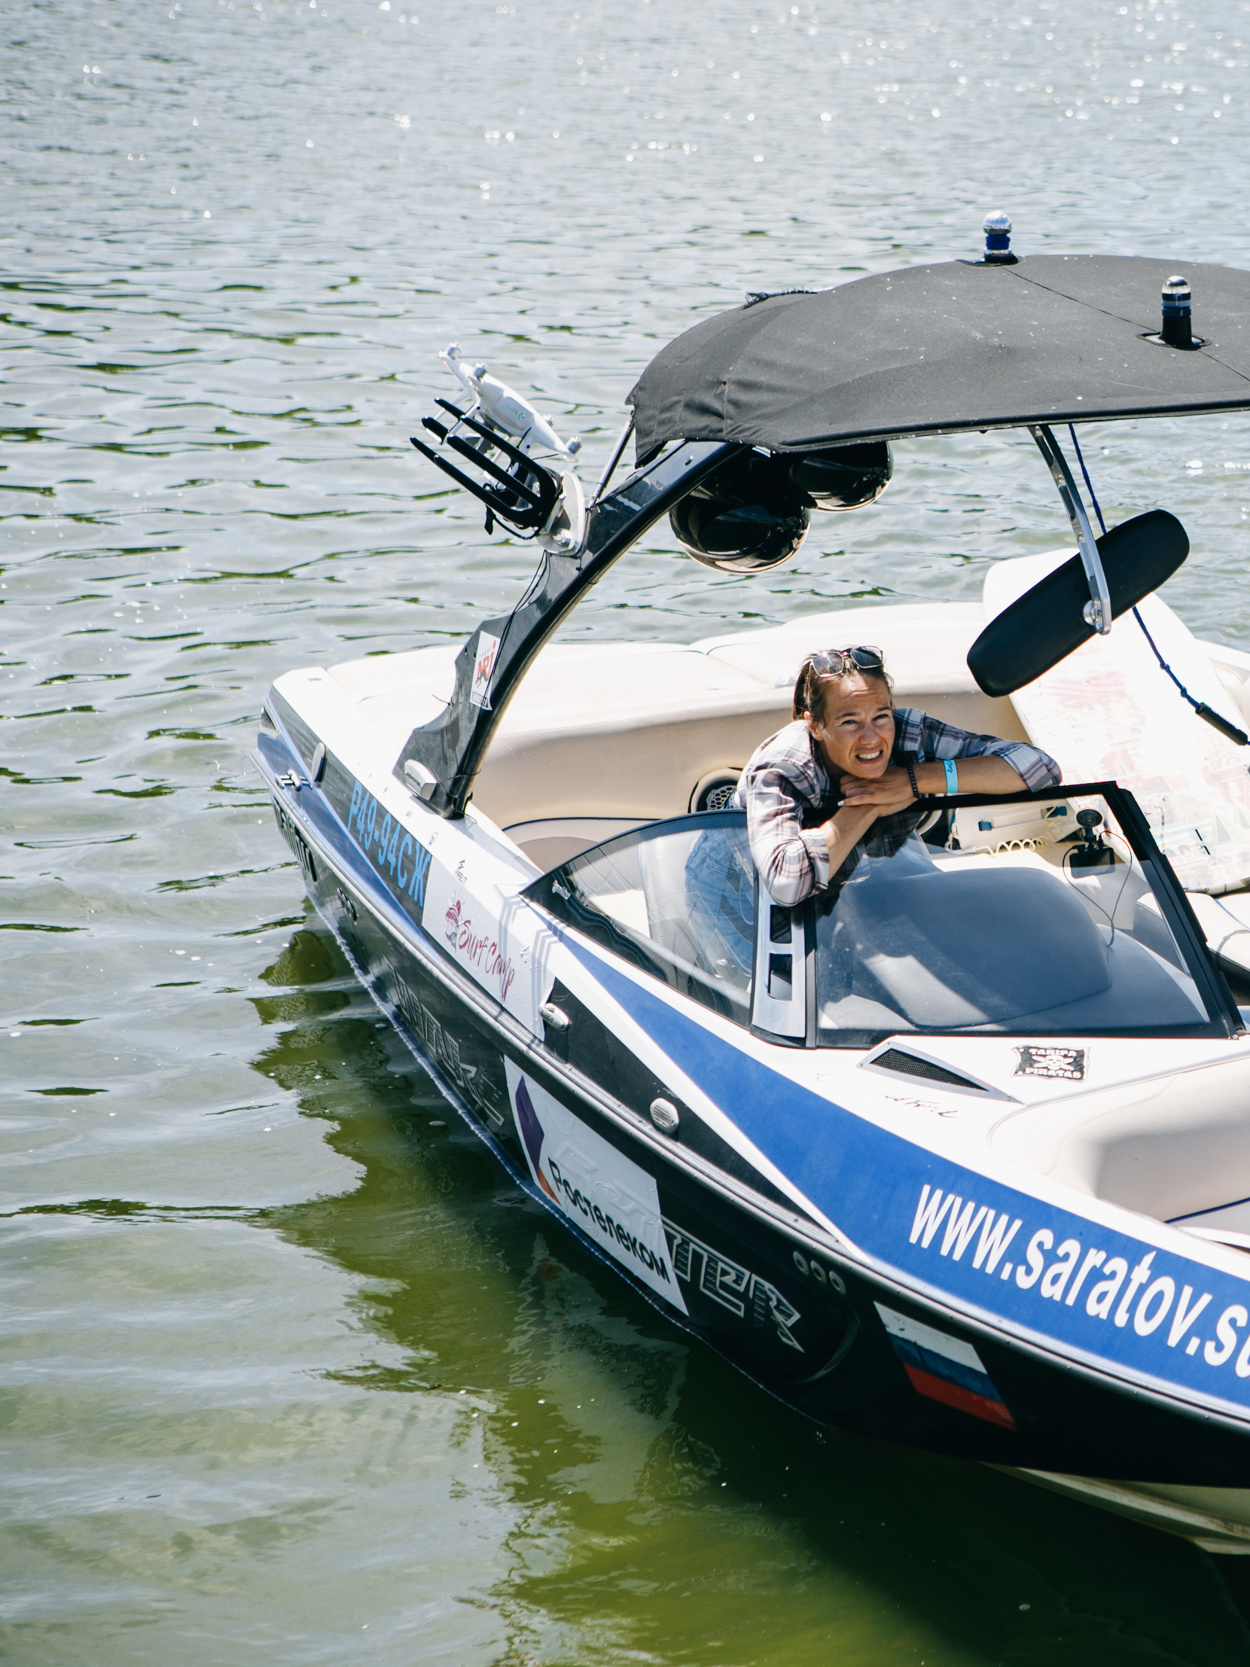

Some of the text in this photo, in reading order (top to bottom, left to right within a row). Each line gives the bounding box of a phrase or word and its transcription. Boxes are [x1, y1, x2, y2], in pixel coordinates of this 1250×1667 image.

[458, 919, 489, 967] Surf
[484, 941, 515, 1003] Camp
[1025, 1067, 1082, 1079] PIRATAS
[547, 1157, 671, 1284] Ростелеком
